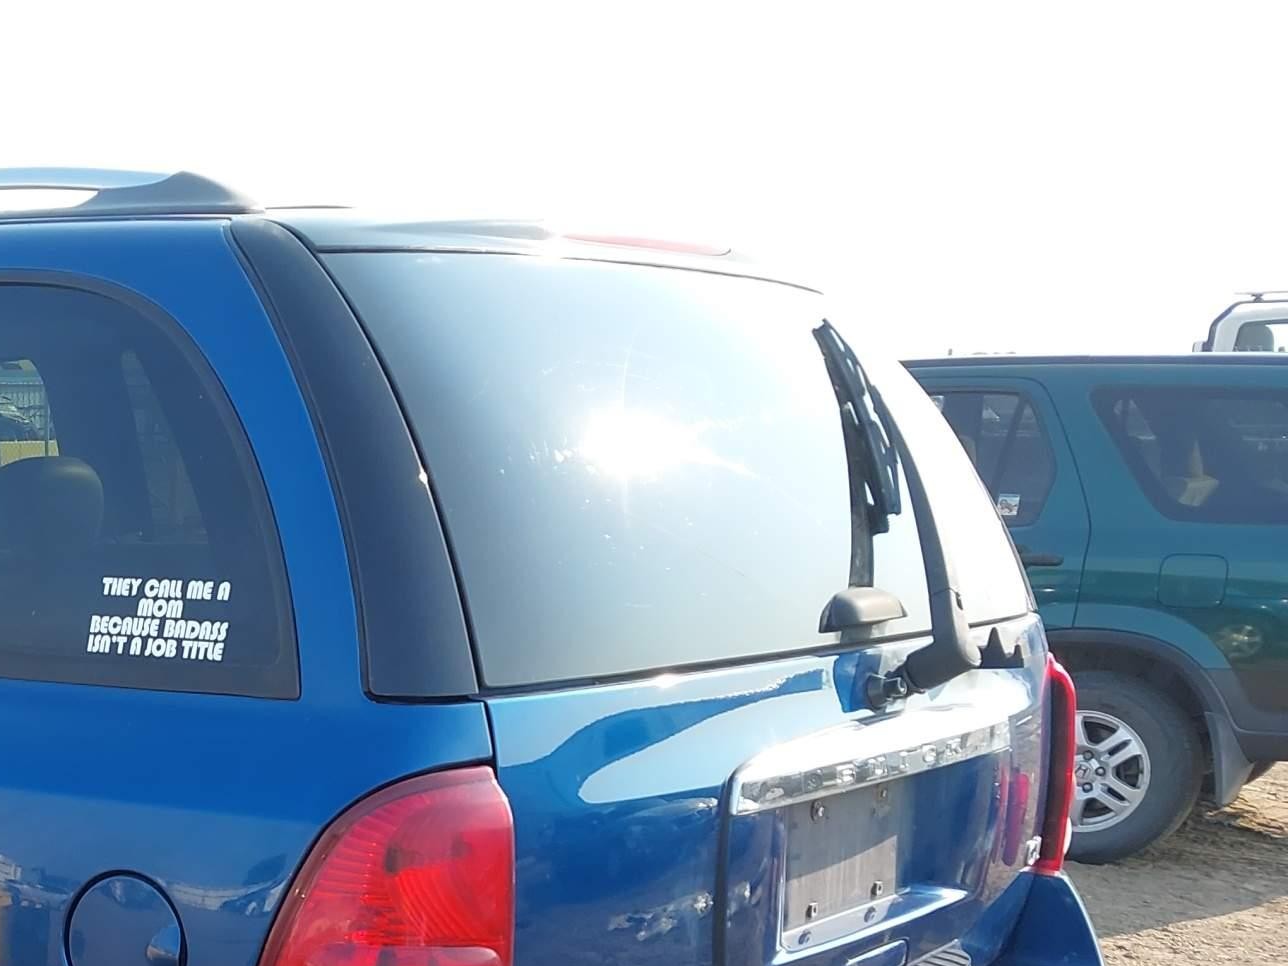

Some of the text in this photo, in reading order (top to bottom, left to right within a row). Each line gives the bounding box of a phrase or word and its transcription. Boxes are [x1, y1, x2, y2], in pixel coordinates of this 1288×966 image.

[102, 577, 232, 601] THEY CALL ME A
[136, 598, 184, 618] MOM
[89, 615, 229, 641] BECAUSE BADASS
[87, 634, 225, 662] ISN'T A JOB TITLE
